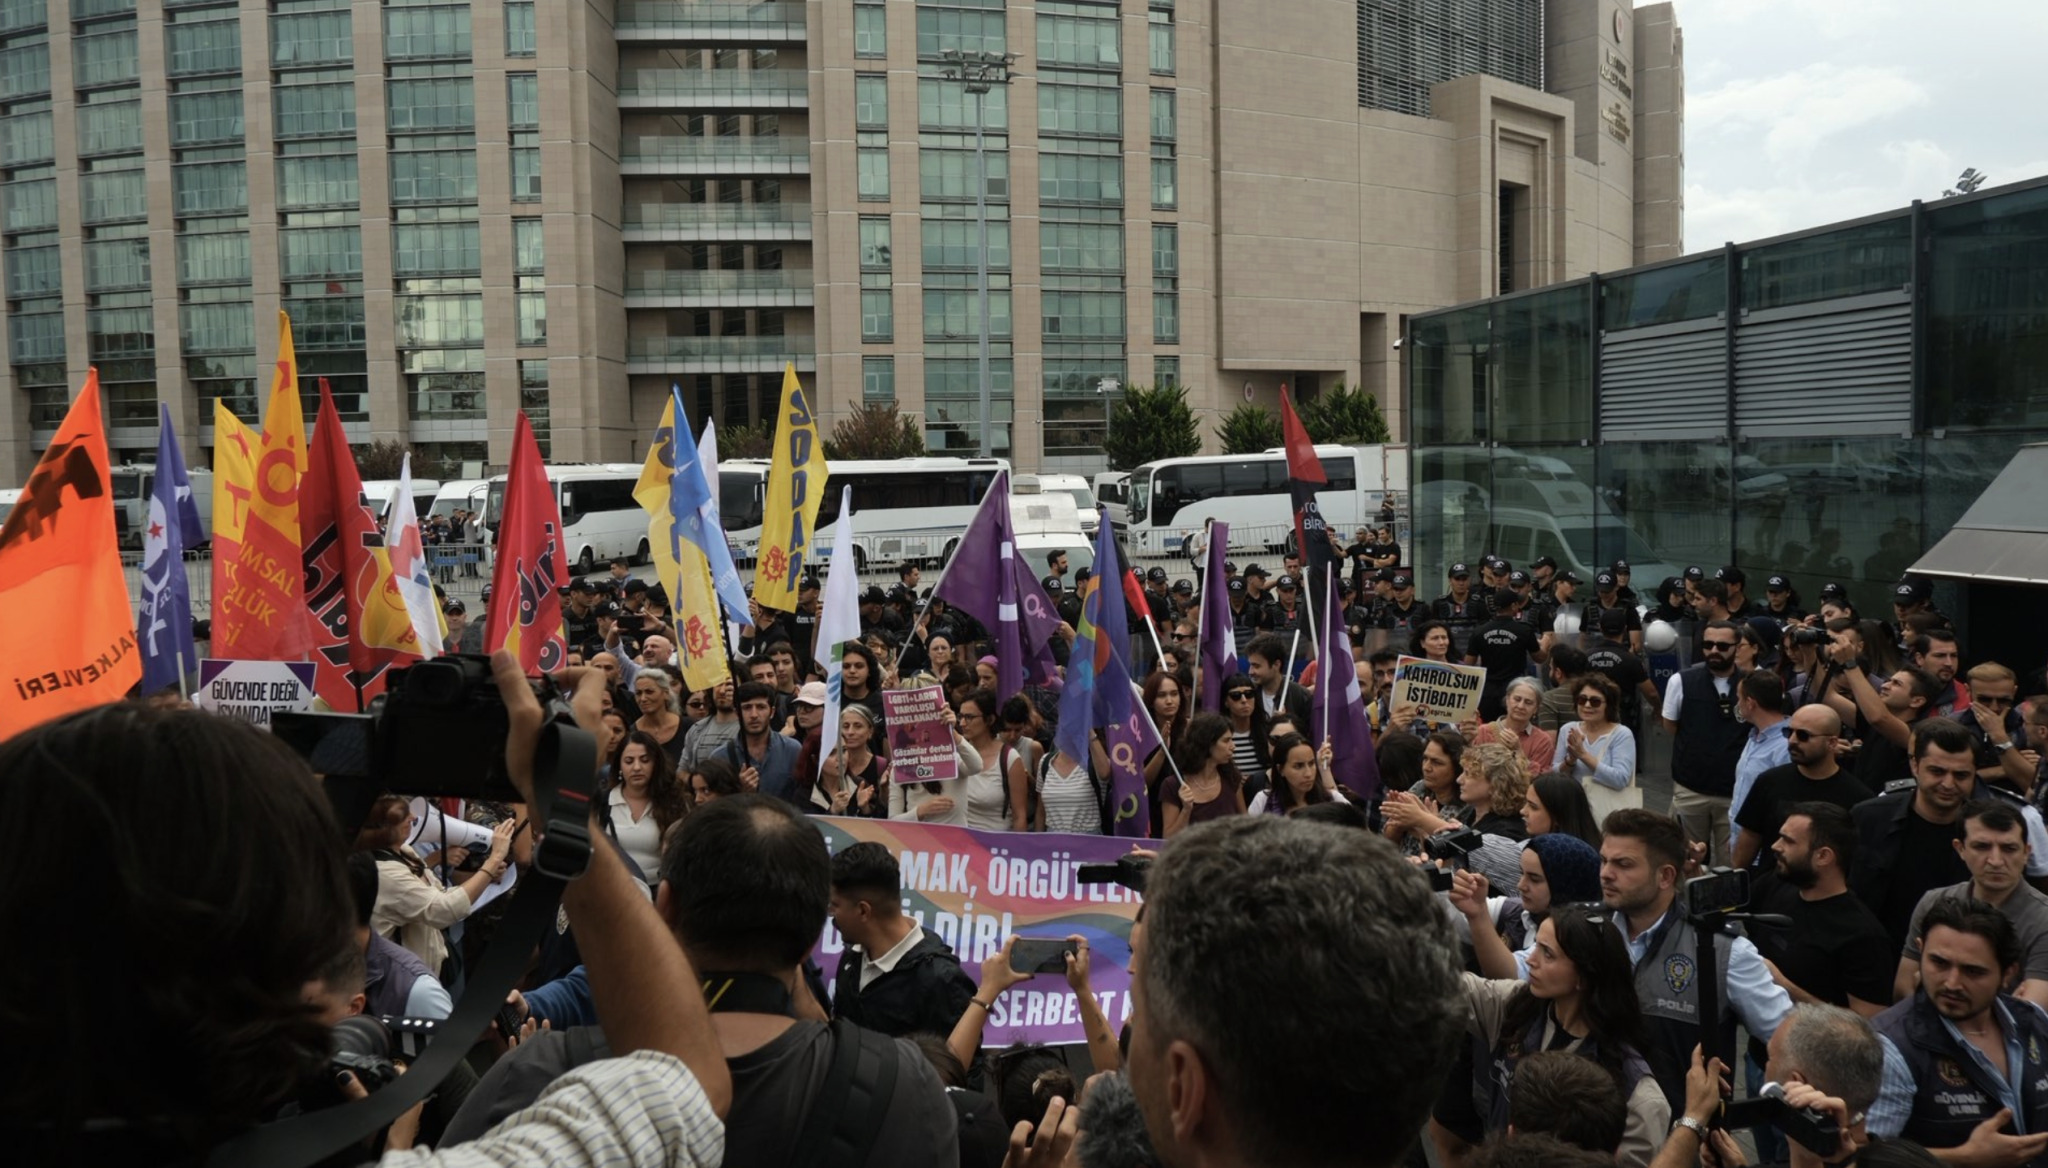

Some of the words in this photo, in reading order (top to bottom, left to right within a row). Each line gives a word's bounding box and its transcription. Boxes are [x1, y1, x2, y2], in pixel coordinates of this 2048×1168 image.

[787, 389, 812, 593] SODAP
[212, 678, 258, 701] GÜVENDE
[270, 679, 299, 702] DEĞİL
[1403, 665, 1479, 691] KAHROLSUN
[1406, 682, 1468, 709] İSTİBDAT!
[893, 702, 936, 715] VAROLUŞU
[929, 744, 953, 753] derhal
[1657, 998, 1695, 1014] POLİS
